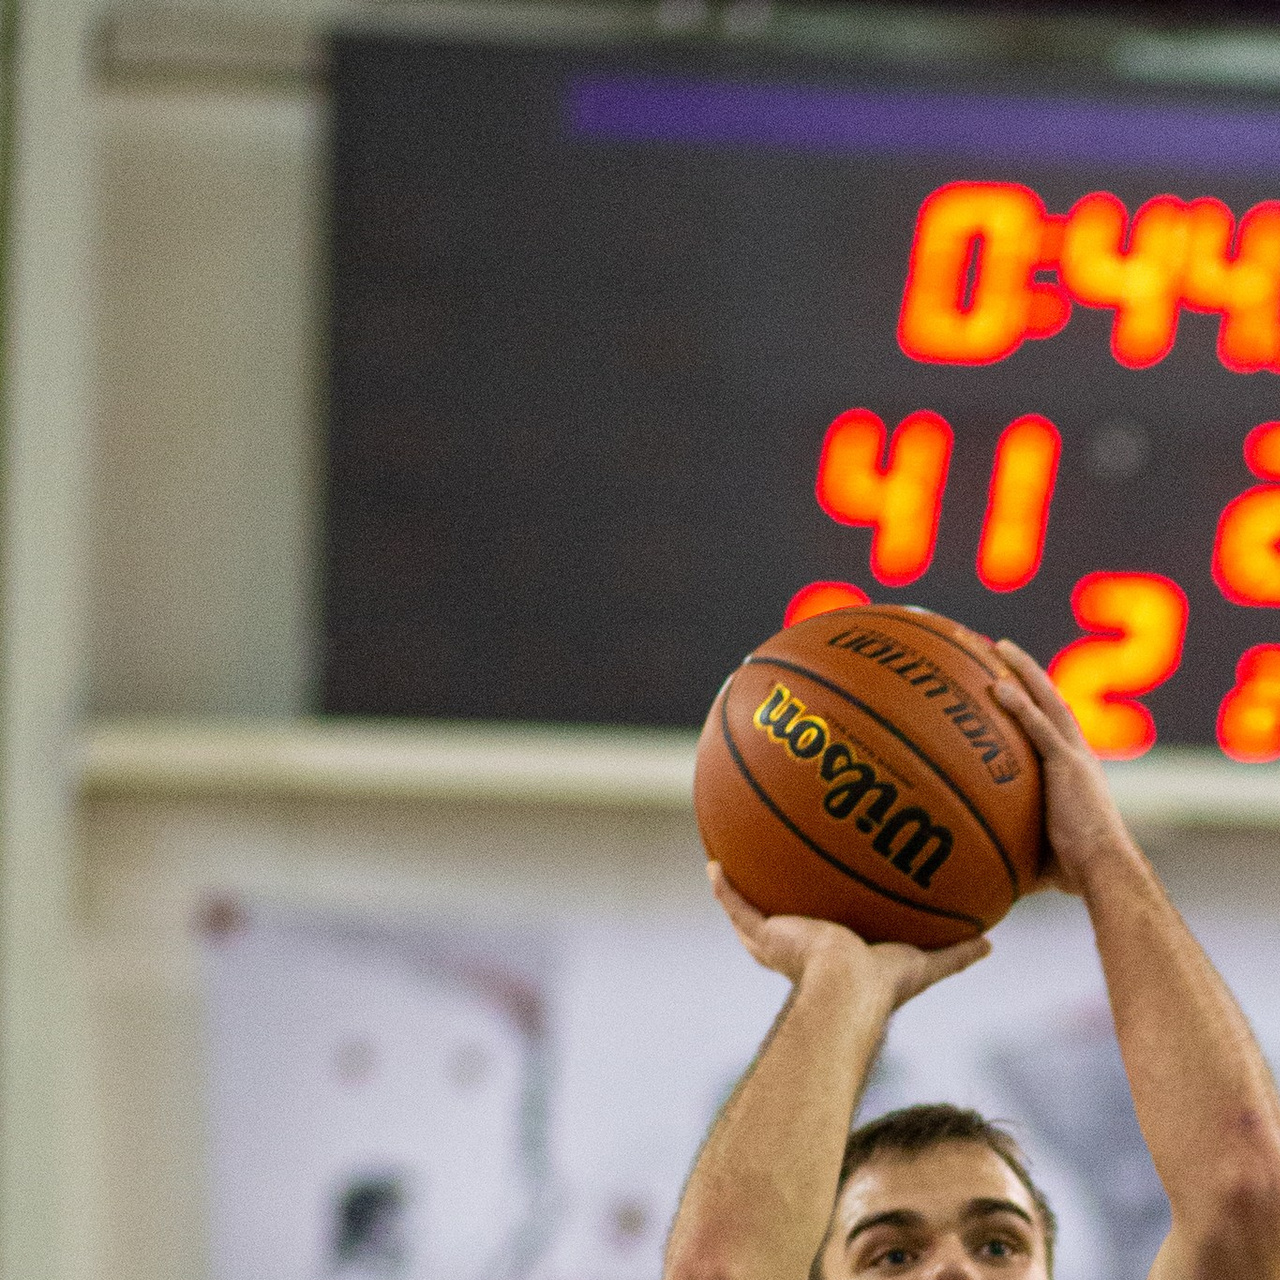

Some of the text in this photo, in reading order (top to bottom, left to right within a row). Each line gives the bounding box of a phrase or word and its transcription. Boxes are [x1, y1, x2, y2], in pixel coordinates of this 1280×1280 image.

[816, 407, 1061, 591] 41
[828, 623, 1020, 786] EVOLUTION
[1048, 571, 1190, 761] 2
[752, 683, 954, 890] Wilson
